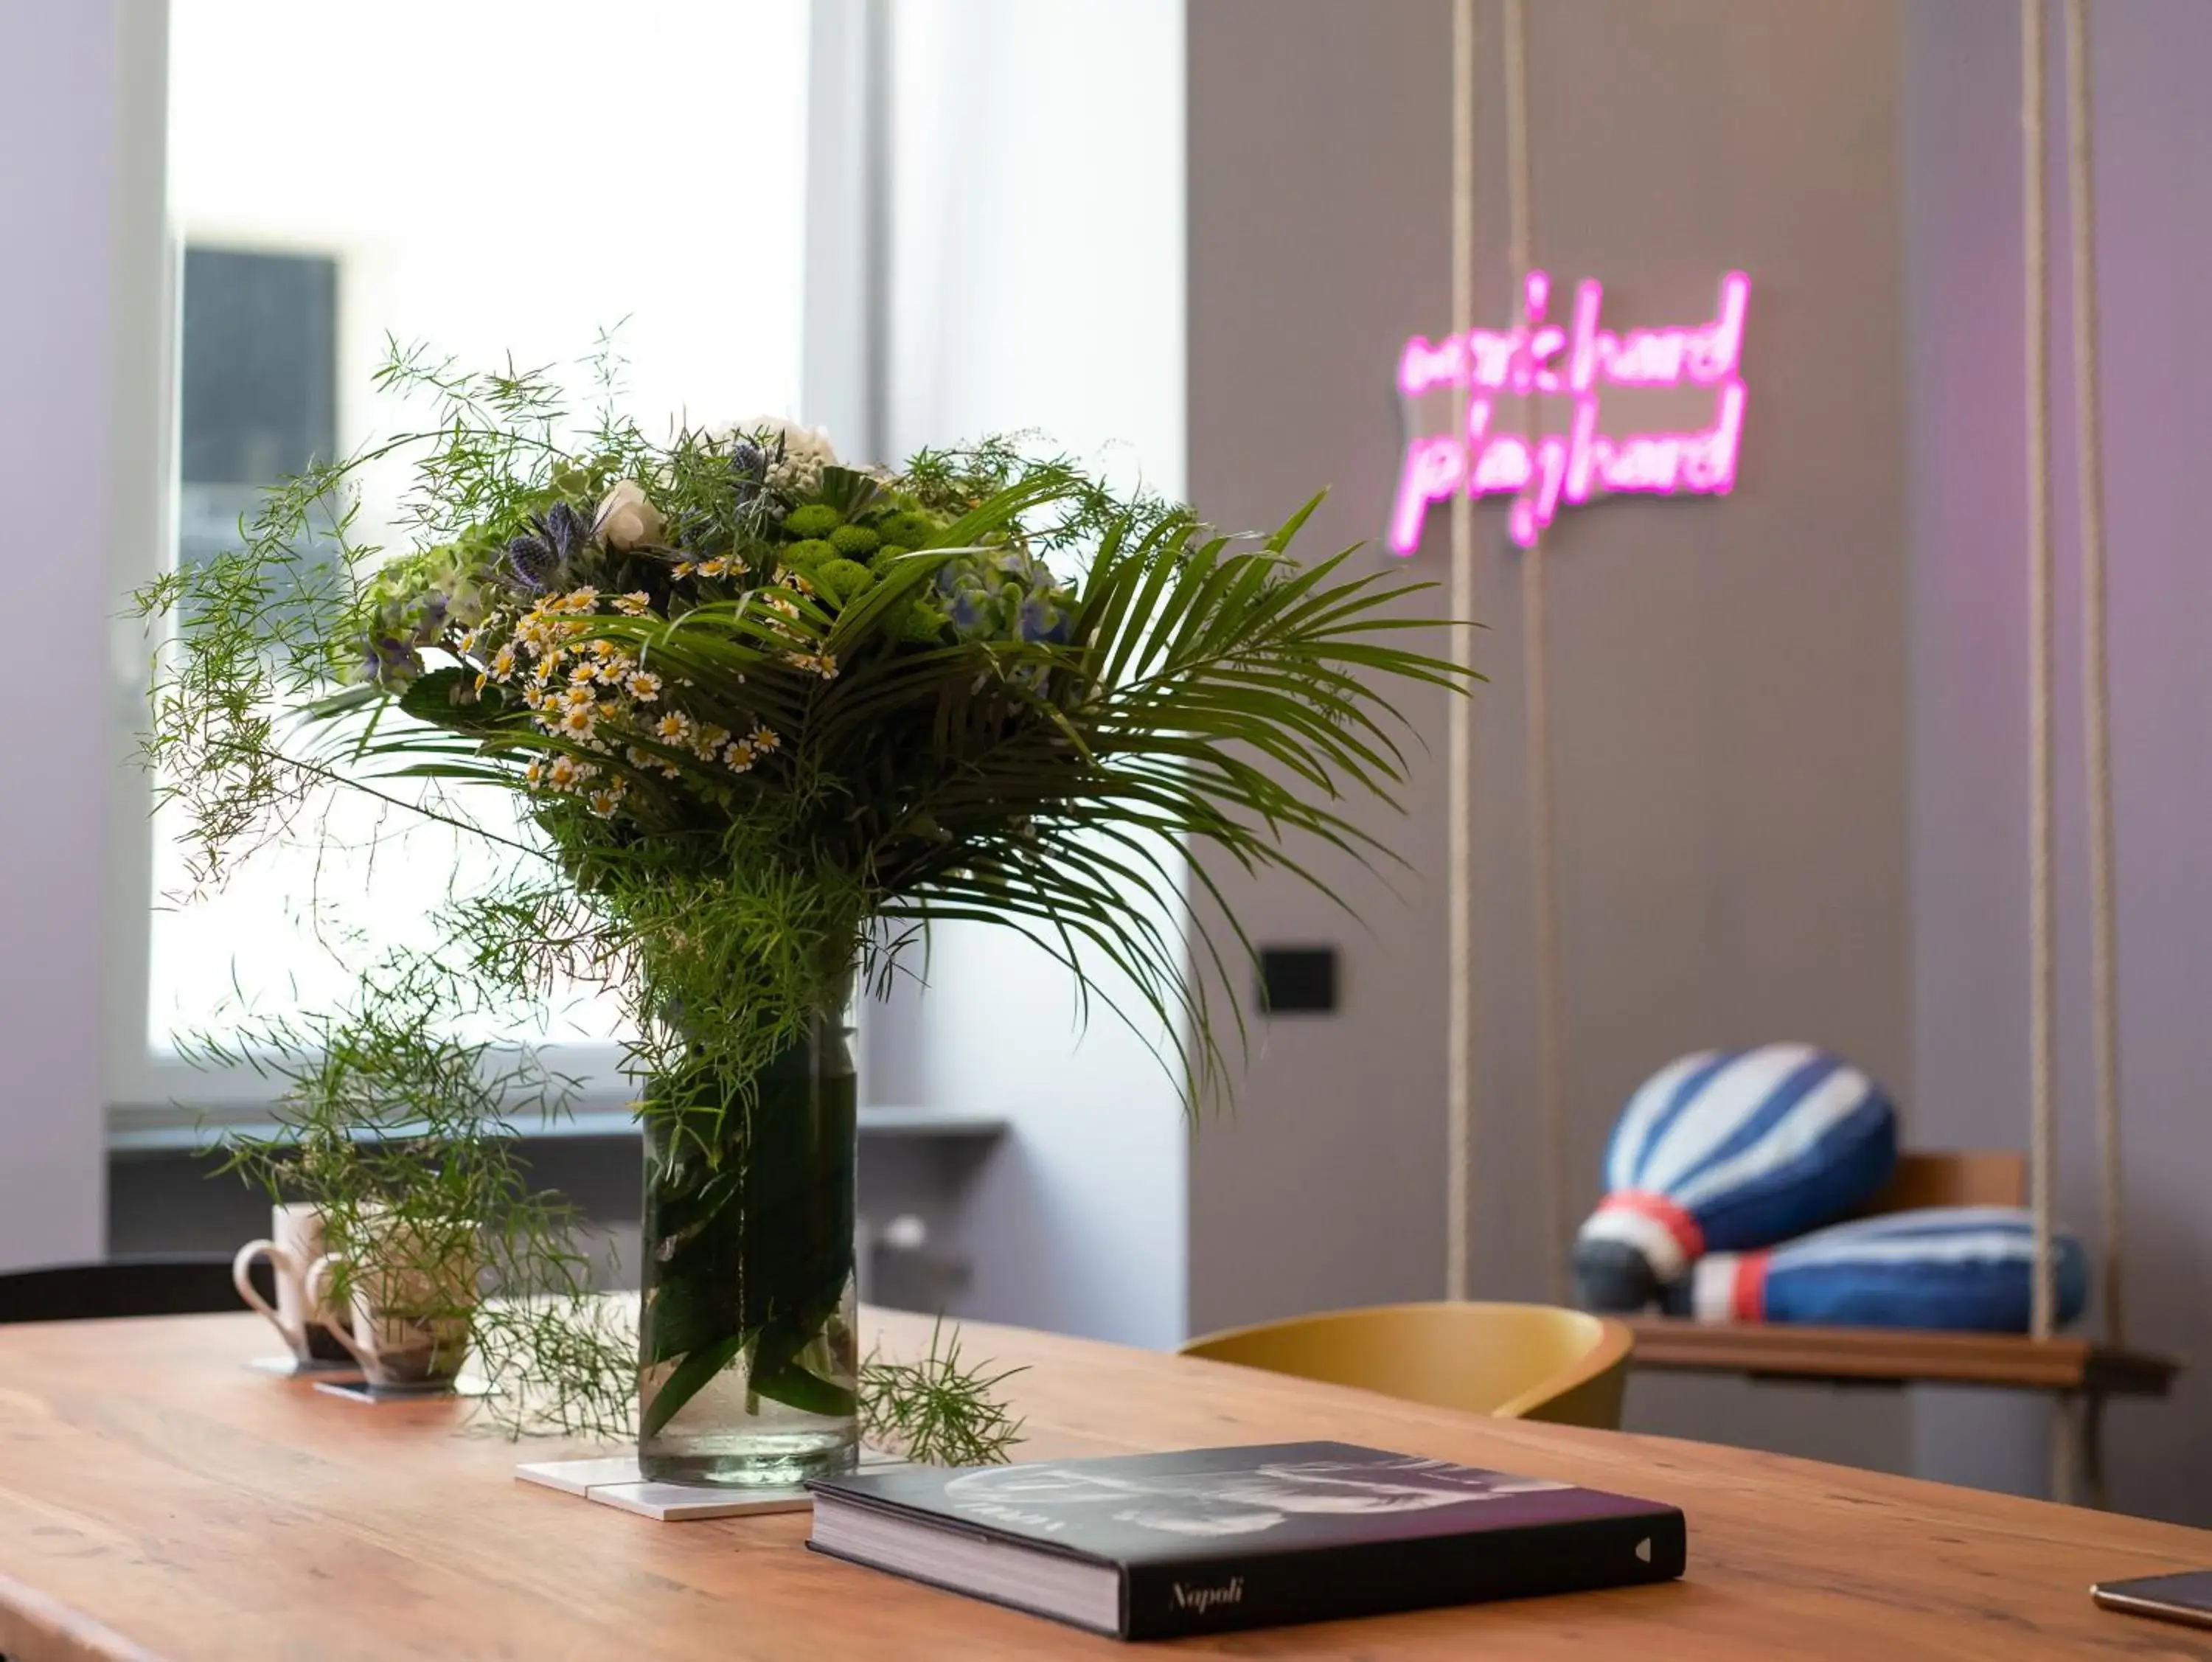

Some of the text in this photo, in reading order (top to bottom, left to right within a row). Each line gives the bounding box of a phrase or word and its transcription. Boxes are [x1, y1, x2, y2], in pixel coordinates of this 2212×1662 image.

[1568, 269, 1752, 394] hard
[1389, 378, 1747, 557] play hard
[1168, 1575, 1245, 1615] Napoli
